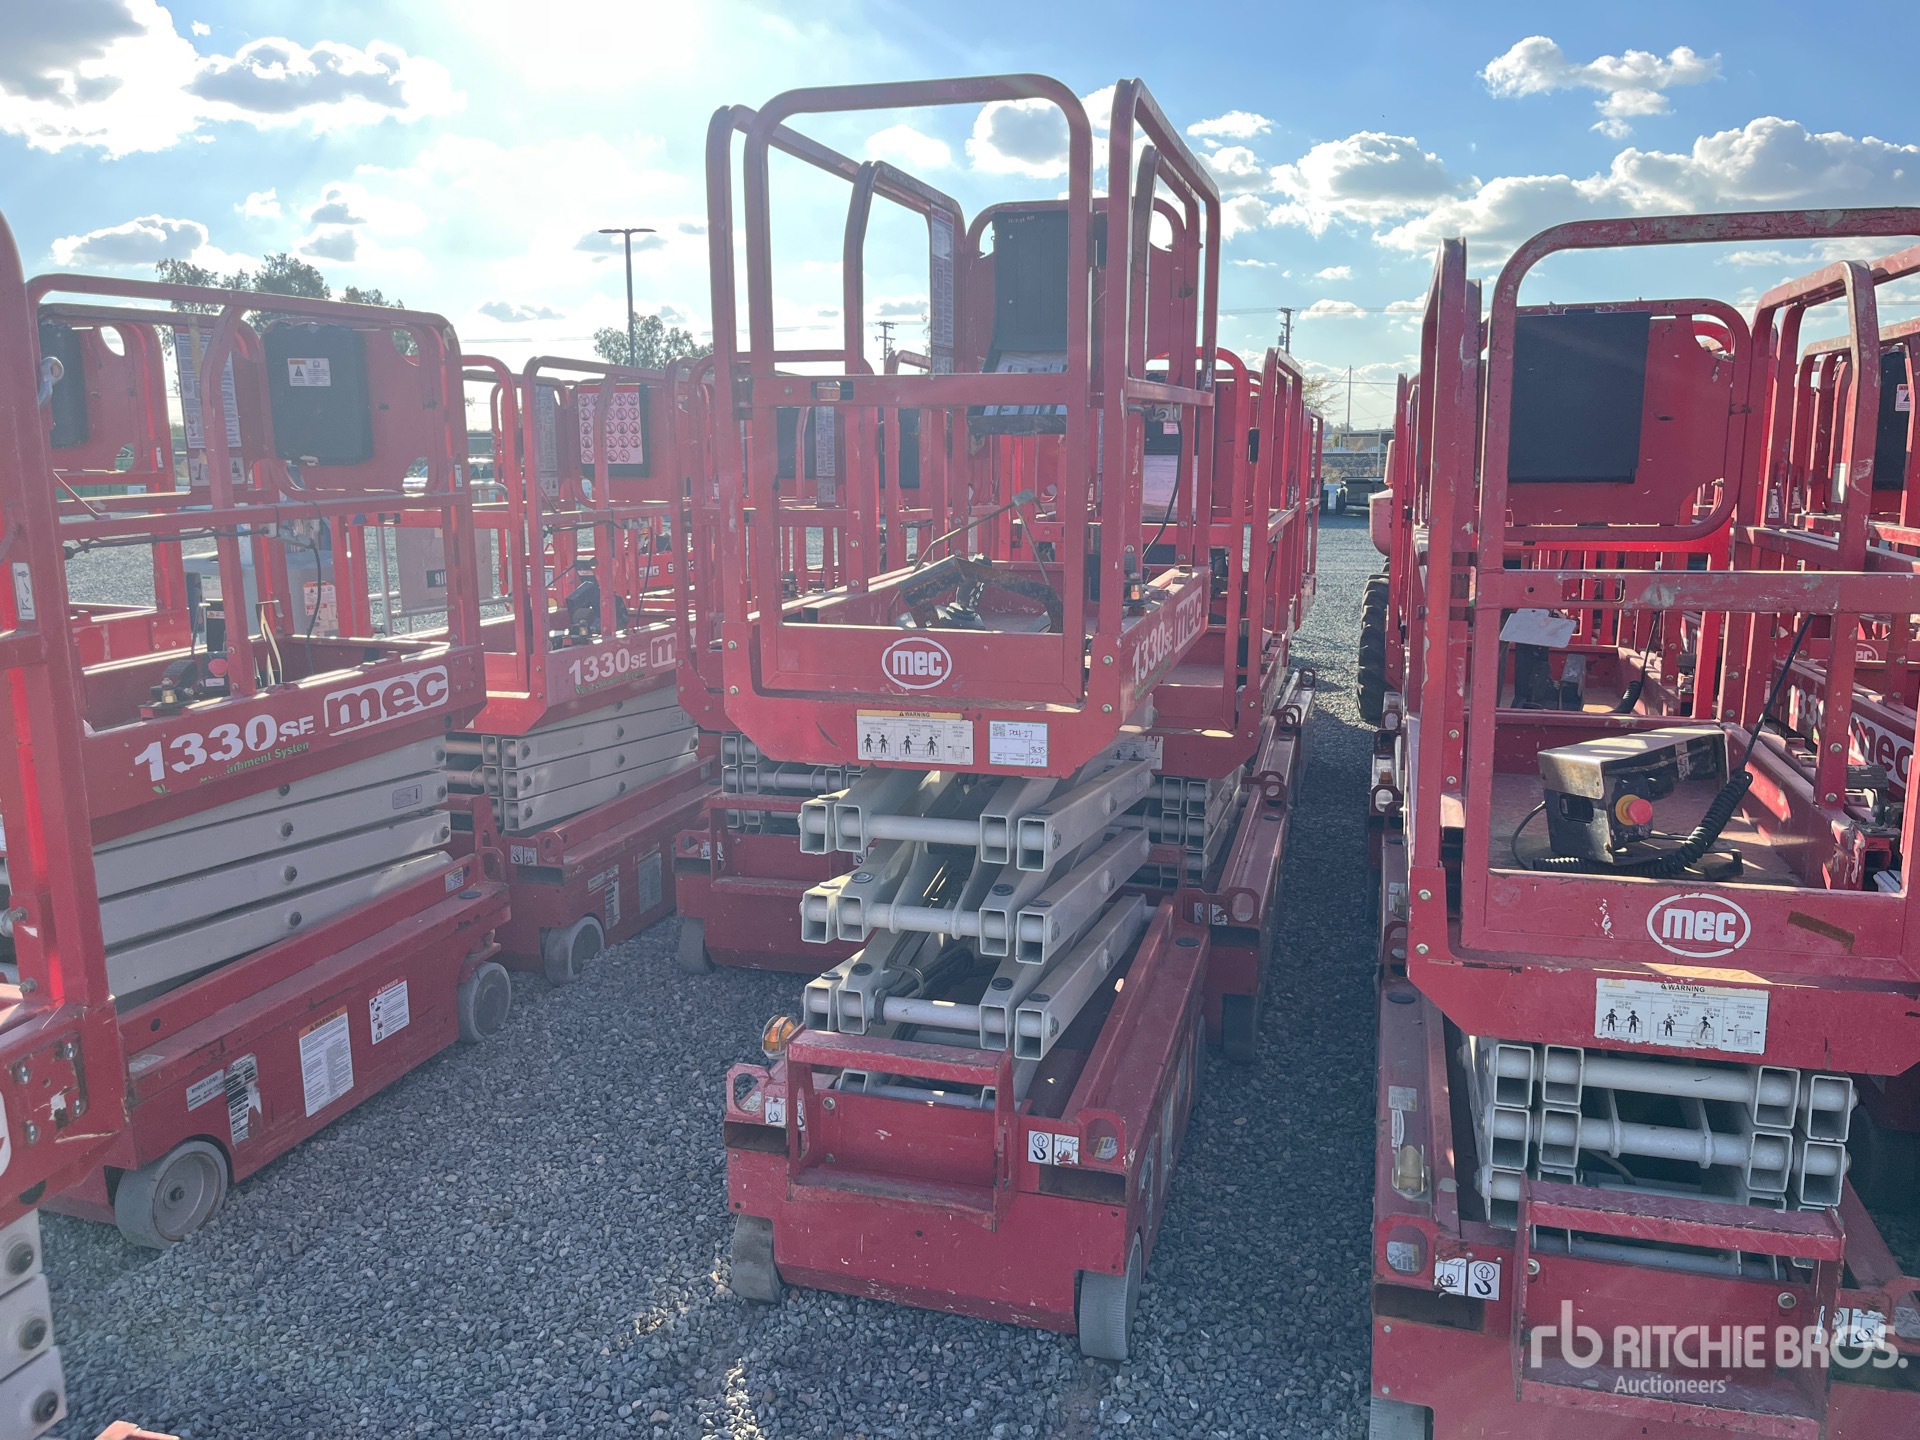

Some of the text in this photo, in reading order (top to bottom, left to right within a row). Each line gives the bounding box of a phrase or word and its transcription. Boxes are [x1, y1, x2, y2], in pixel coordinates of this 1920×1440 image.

[569, 648, 647, 686] 1330SE
[893, 650, 942, 676] mec
[327, 670, 448, 728] mec
[1662, 908, 1737, 943] mec
[1667, 984, 1706, 993] WARNING
